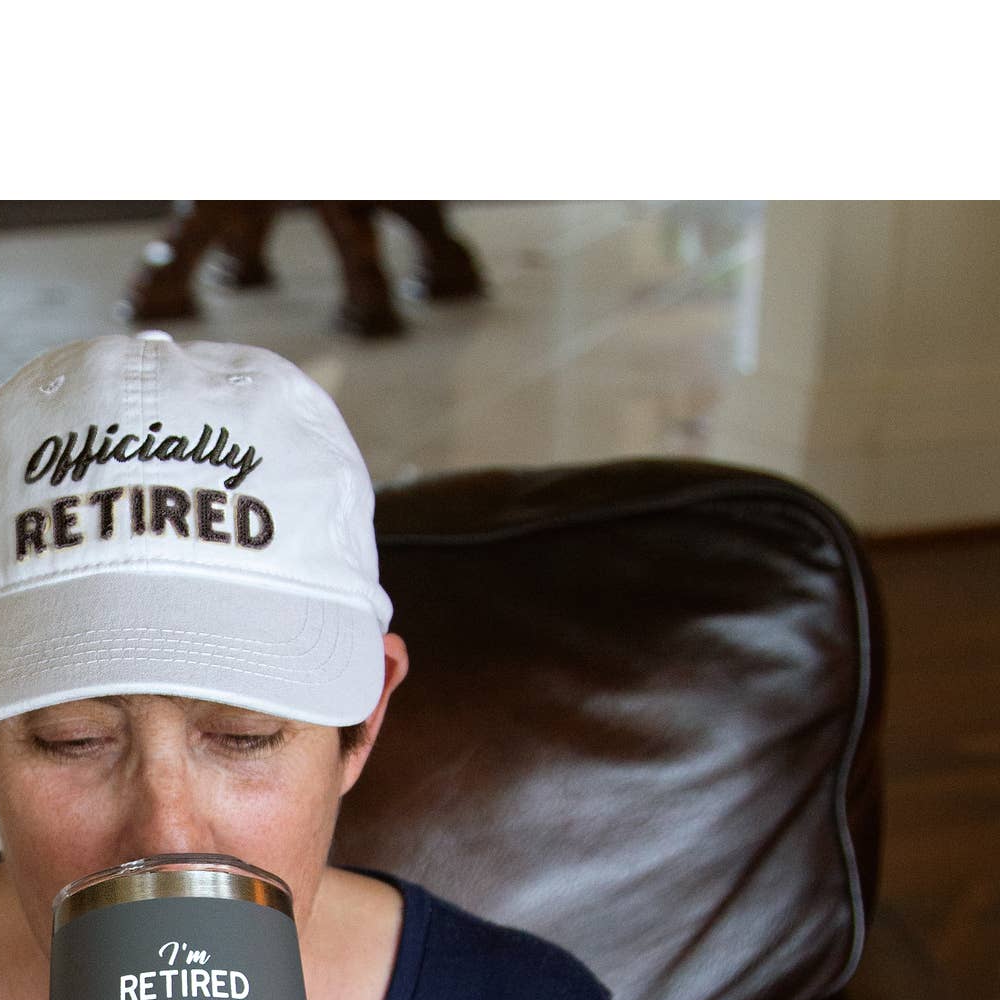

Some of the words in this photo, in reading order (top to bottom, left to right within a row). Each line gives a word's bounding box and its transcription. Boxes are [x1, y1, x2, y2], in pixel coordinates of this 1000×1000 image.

[24, 421, 263, 489] Officially
[15, 484, 275, 561] RETIRED
[158, 941, 211, 966] I'm
